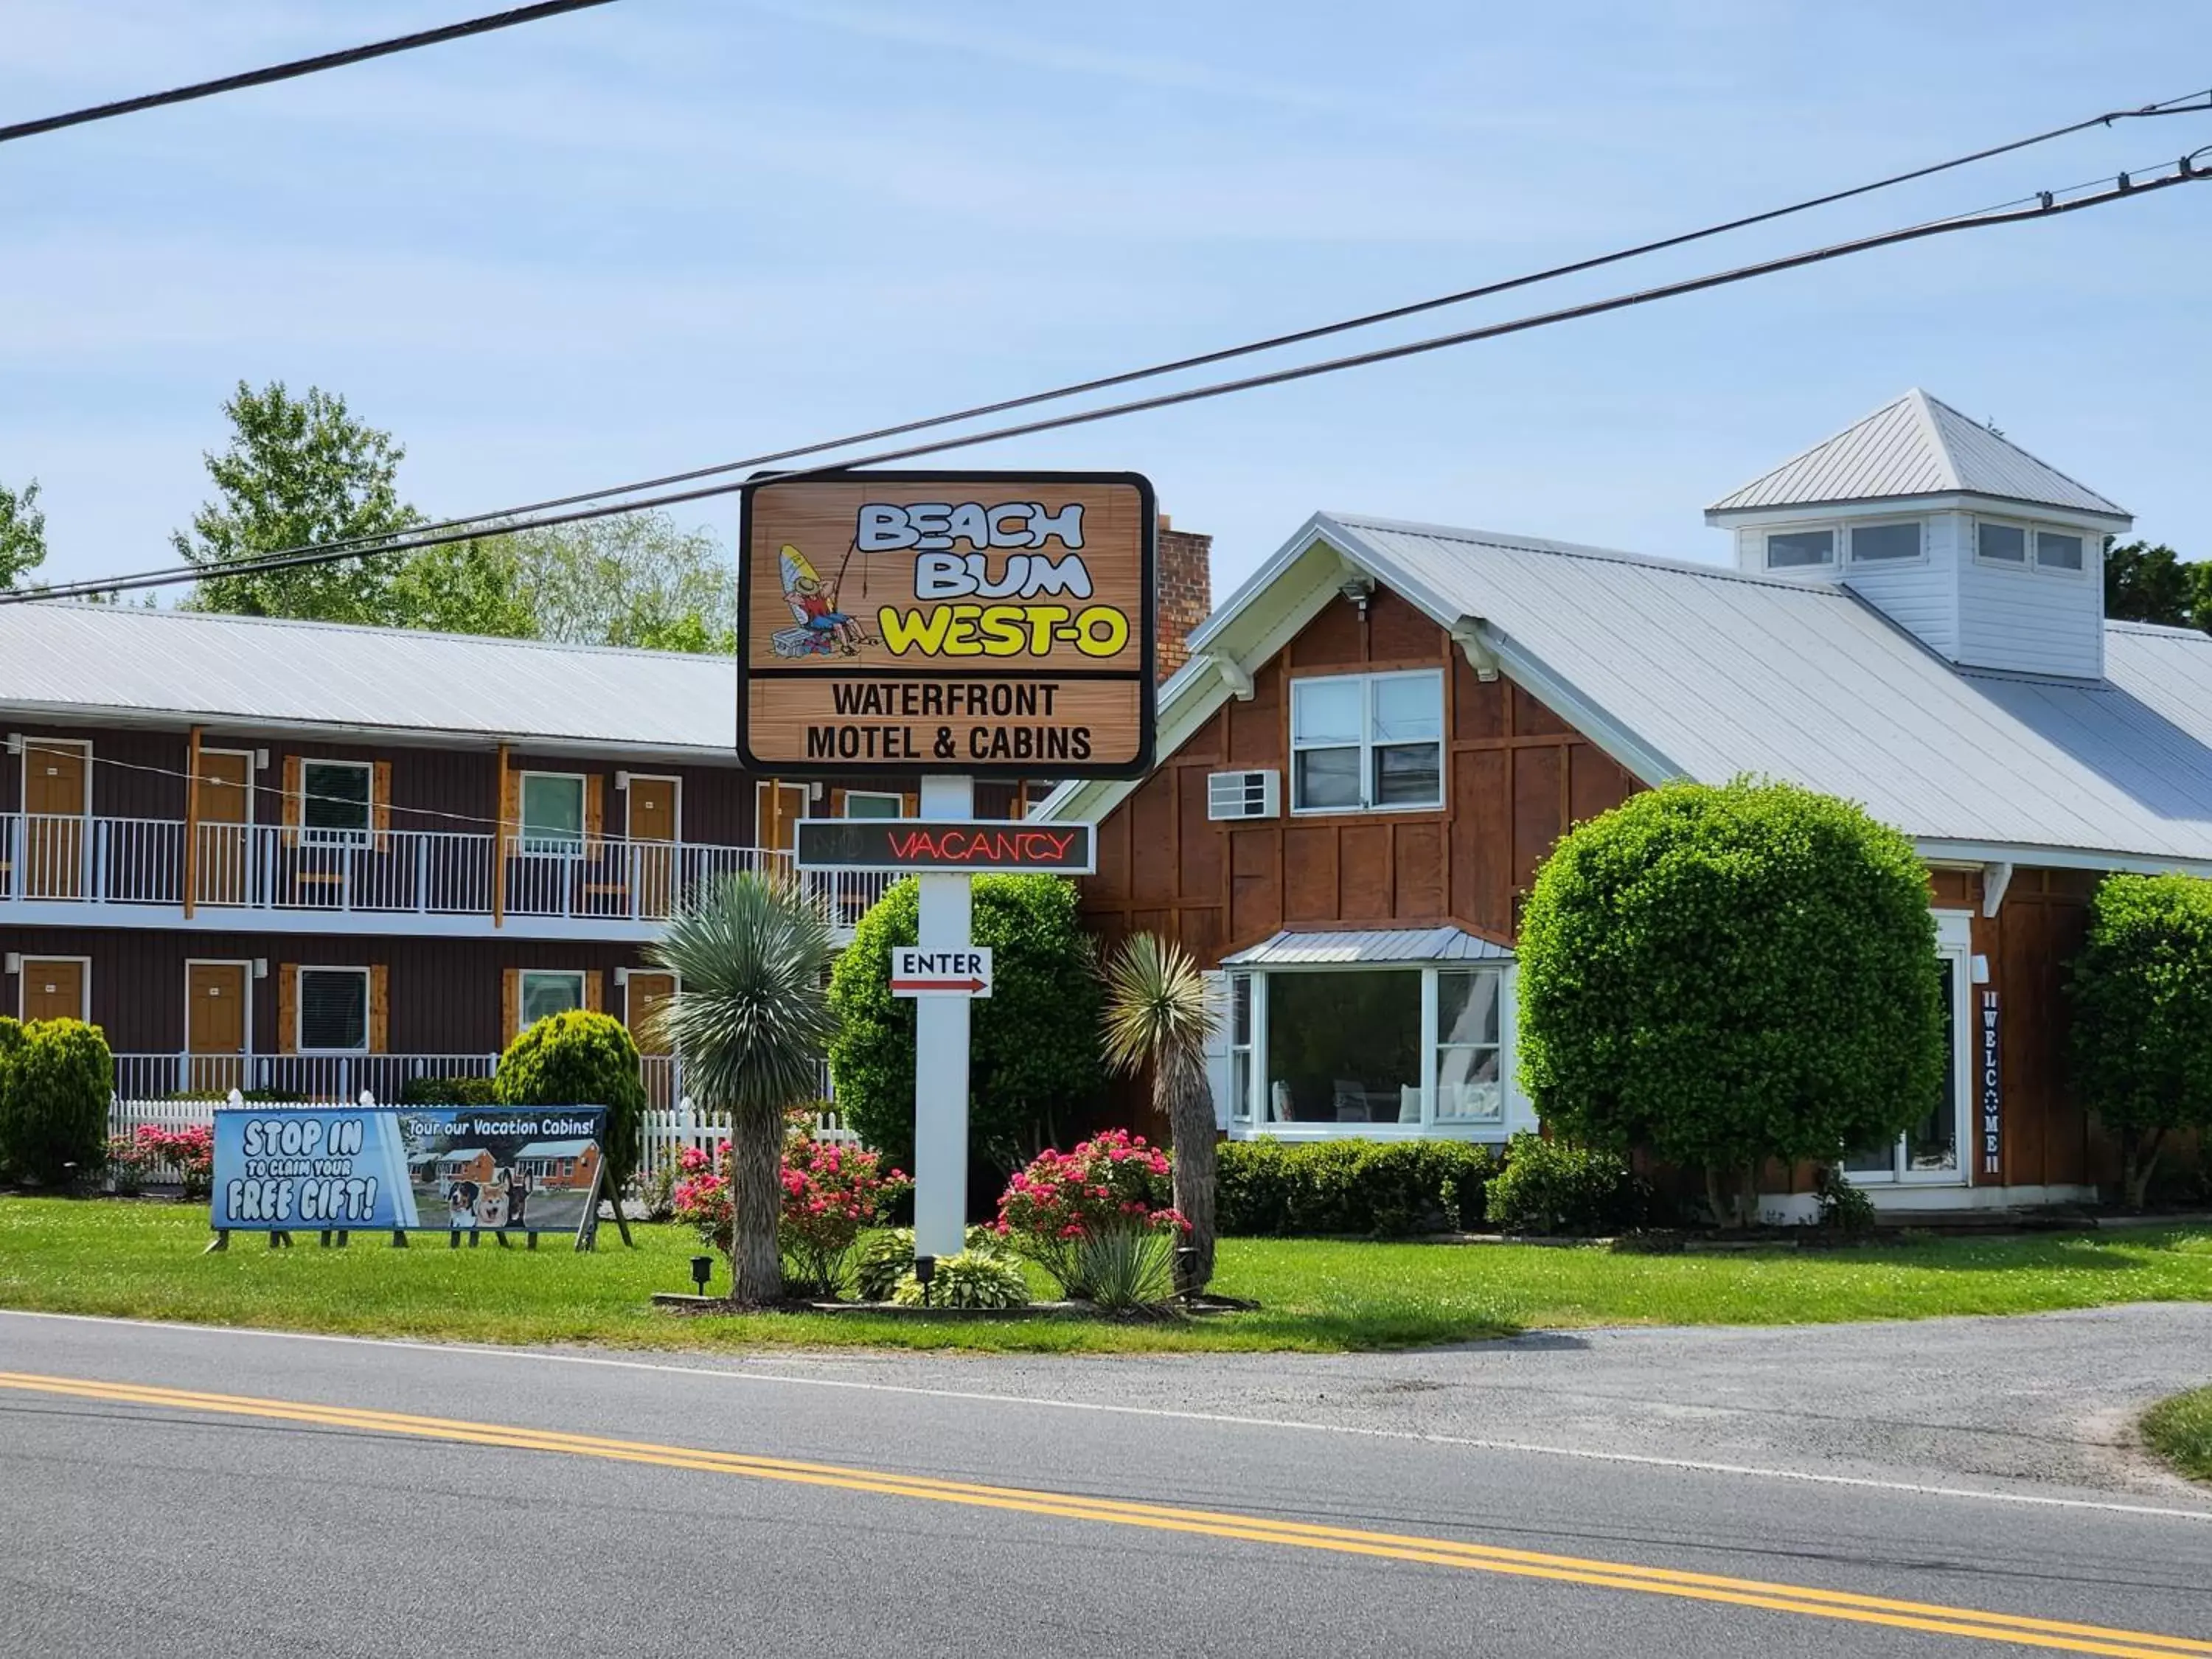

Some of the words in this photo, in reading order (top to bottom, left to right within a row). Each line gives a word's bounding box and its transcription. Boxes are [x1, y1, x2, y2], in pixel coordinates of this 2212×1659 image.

[858, 502, 1085, 552] BEACH
[914, 552, 1093, 600] BUM
[877, 605, 1130, 658] WEST-O
[833, 684, 1059, 716] WATERFRONT
[807, 726, 920, 759] MOTEL
[933, 726, 956, 759] &
[970, 726, 1091, 760] CABINS
[888, 831, 1074, 861] VACANCY
[903, 954, 982, 974] ENTER
[1983, 1011, 1998, 1152] WELCOME
[243, 1119, 323, 1156] STOP
[327, 1119, 363, 1155] IN
[409, 1120, 440, 1135] Tour
[445, 1122, 469, 1135] our
[474, 1119, 538, 1135] Vacation
[542, 1119, 594, 1135] Cabins!
[246, 1158, 267, 1177] TO
[268, 1159, 312, 1177] CLAIM
[313, 1158, 352, 1177] YOUR
[226, 1178, 293, 1221] FREE
[299, 1177, 378, 1220] GIFT!
